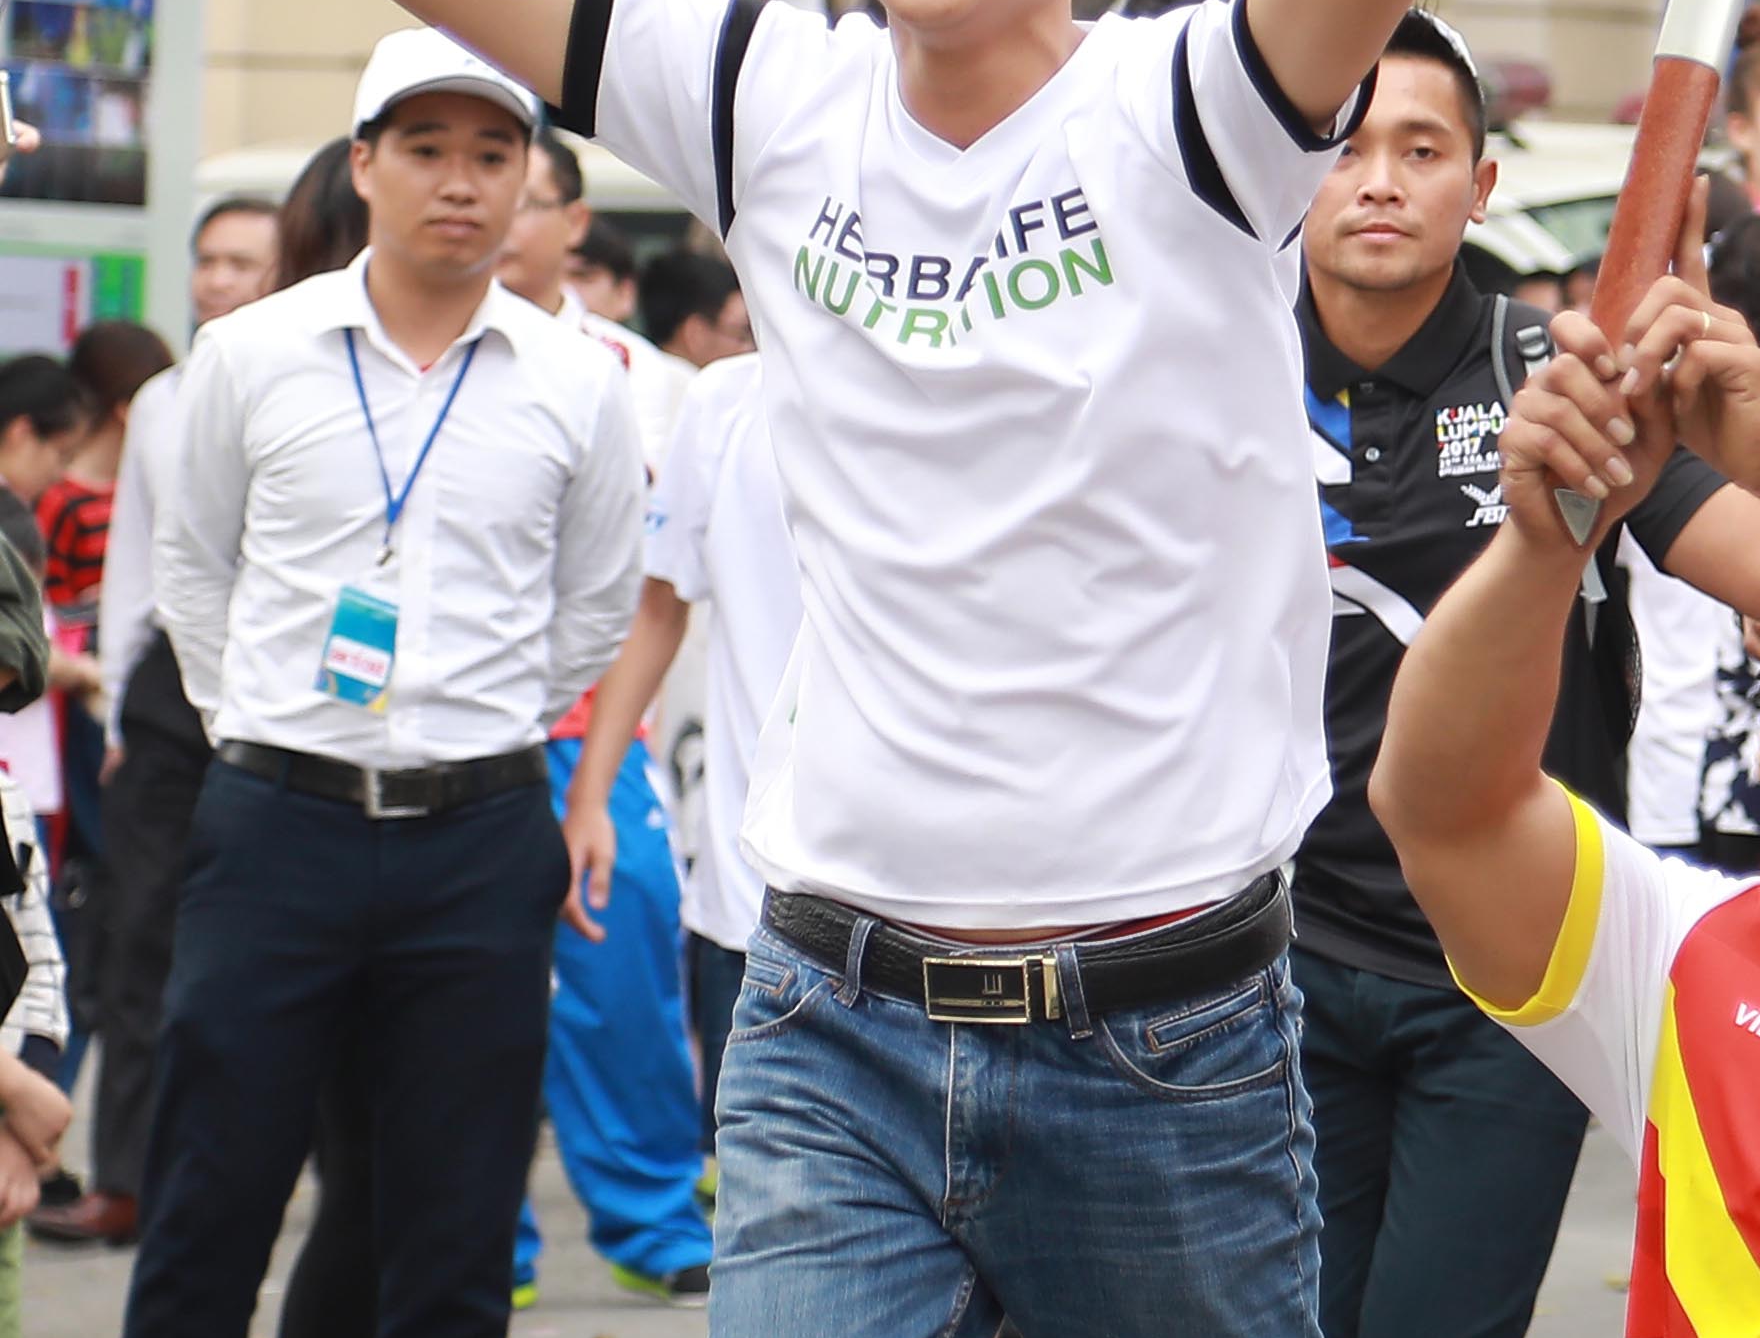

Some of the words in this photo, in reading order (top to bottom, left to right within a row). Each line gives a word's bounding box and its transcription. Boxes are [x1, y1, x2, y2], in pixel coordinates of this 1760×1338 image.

[1437, 401, 1505, 426] KUALA
[1437, 417, 1507, 442] LUMPU
[1438, 437, 1482, 459] 2017
